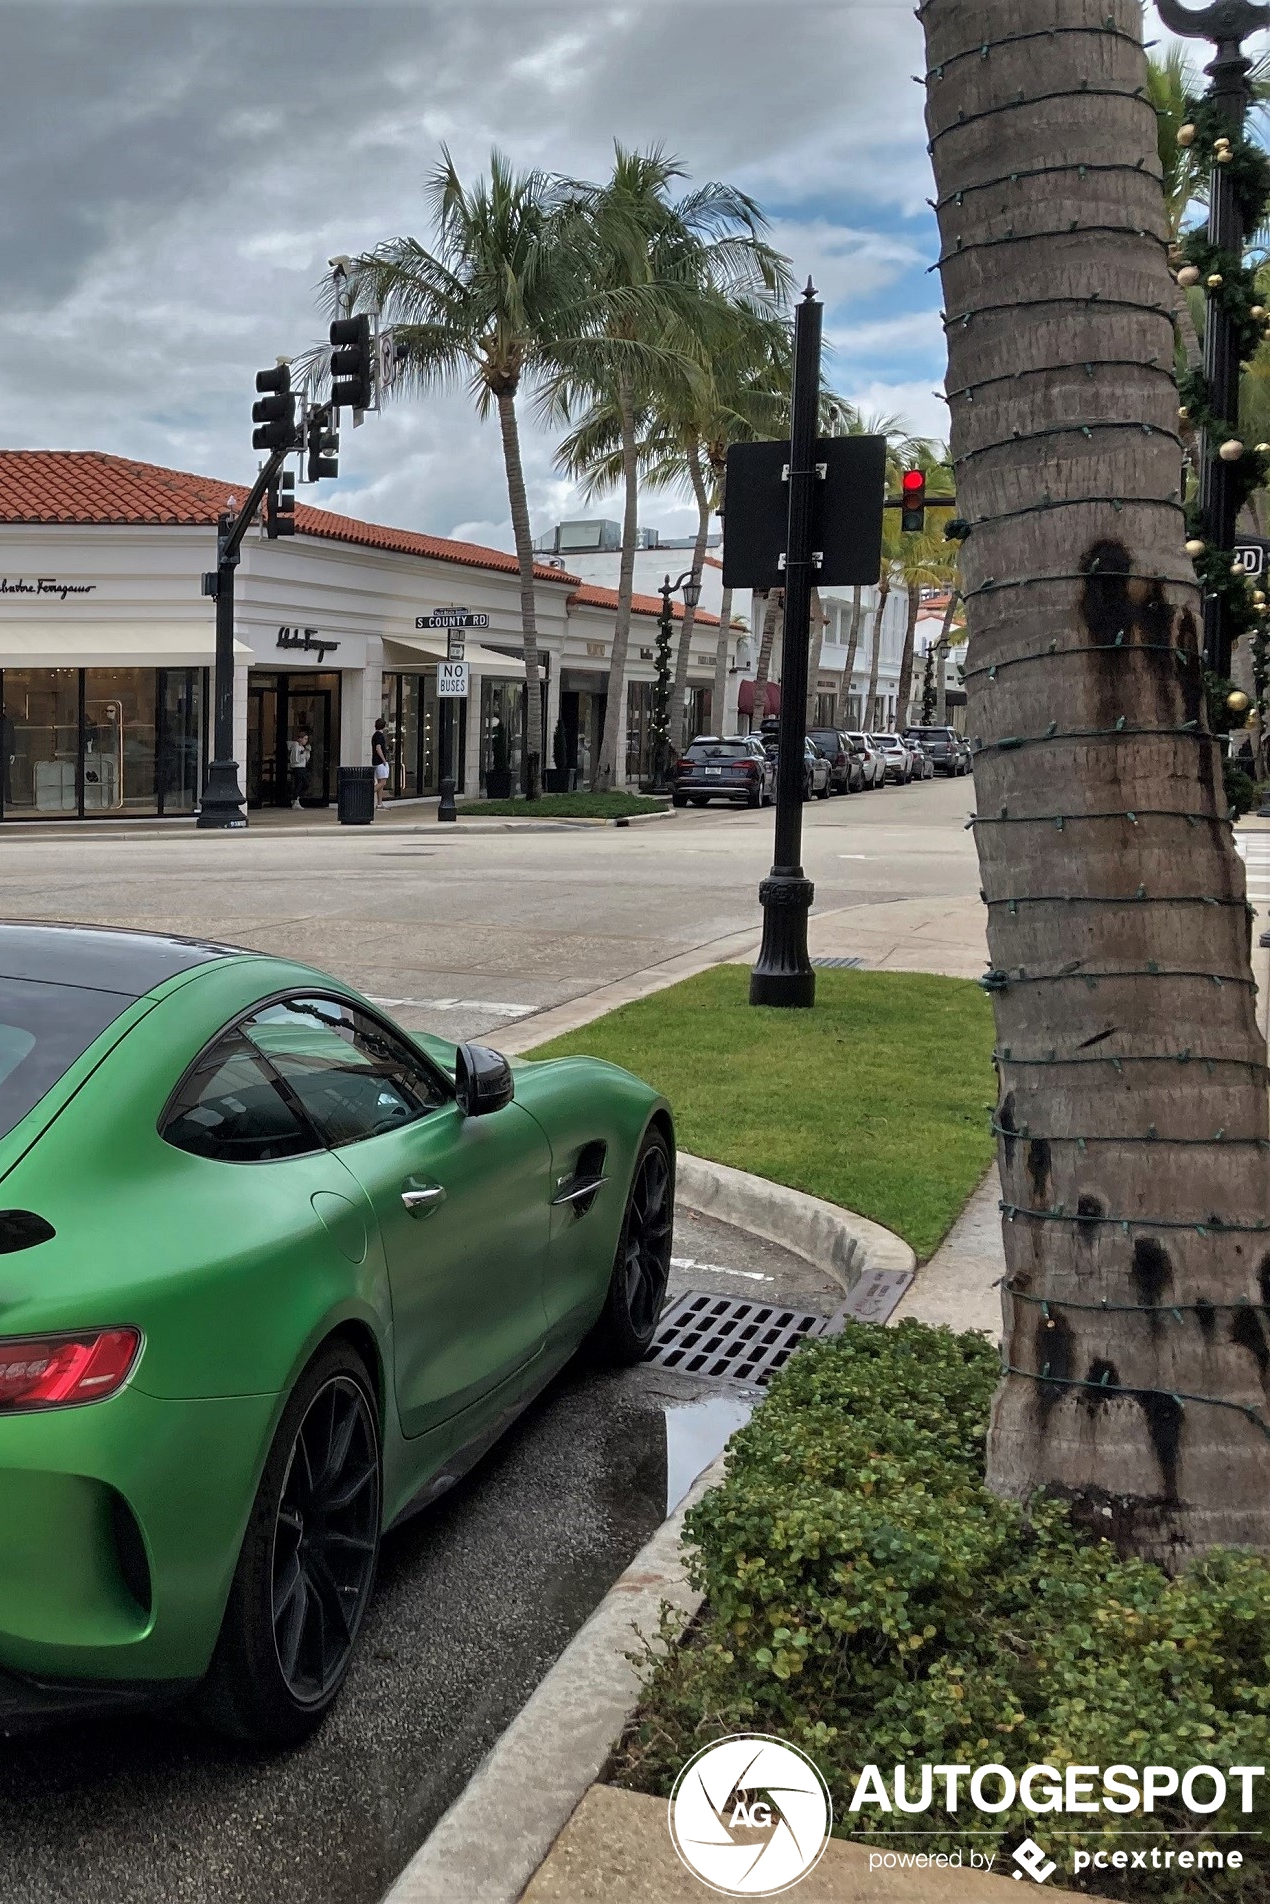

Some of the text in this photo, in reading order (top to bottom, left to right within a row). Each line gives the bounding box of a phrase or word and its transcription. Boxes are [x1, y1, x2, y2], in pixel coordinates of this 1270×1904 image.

[36, 579, 96, 600] Ferragamo
[417, 615, 486, 628] S COUNTY RD
[444, 665, 463, 677] NO
[440, 679, 465, 692] BUSES
